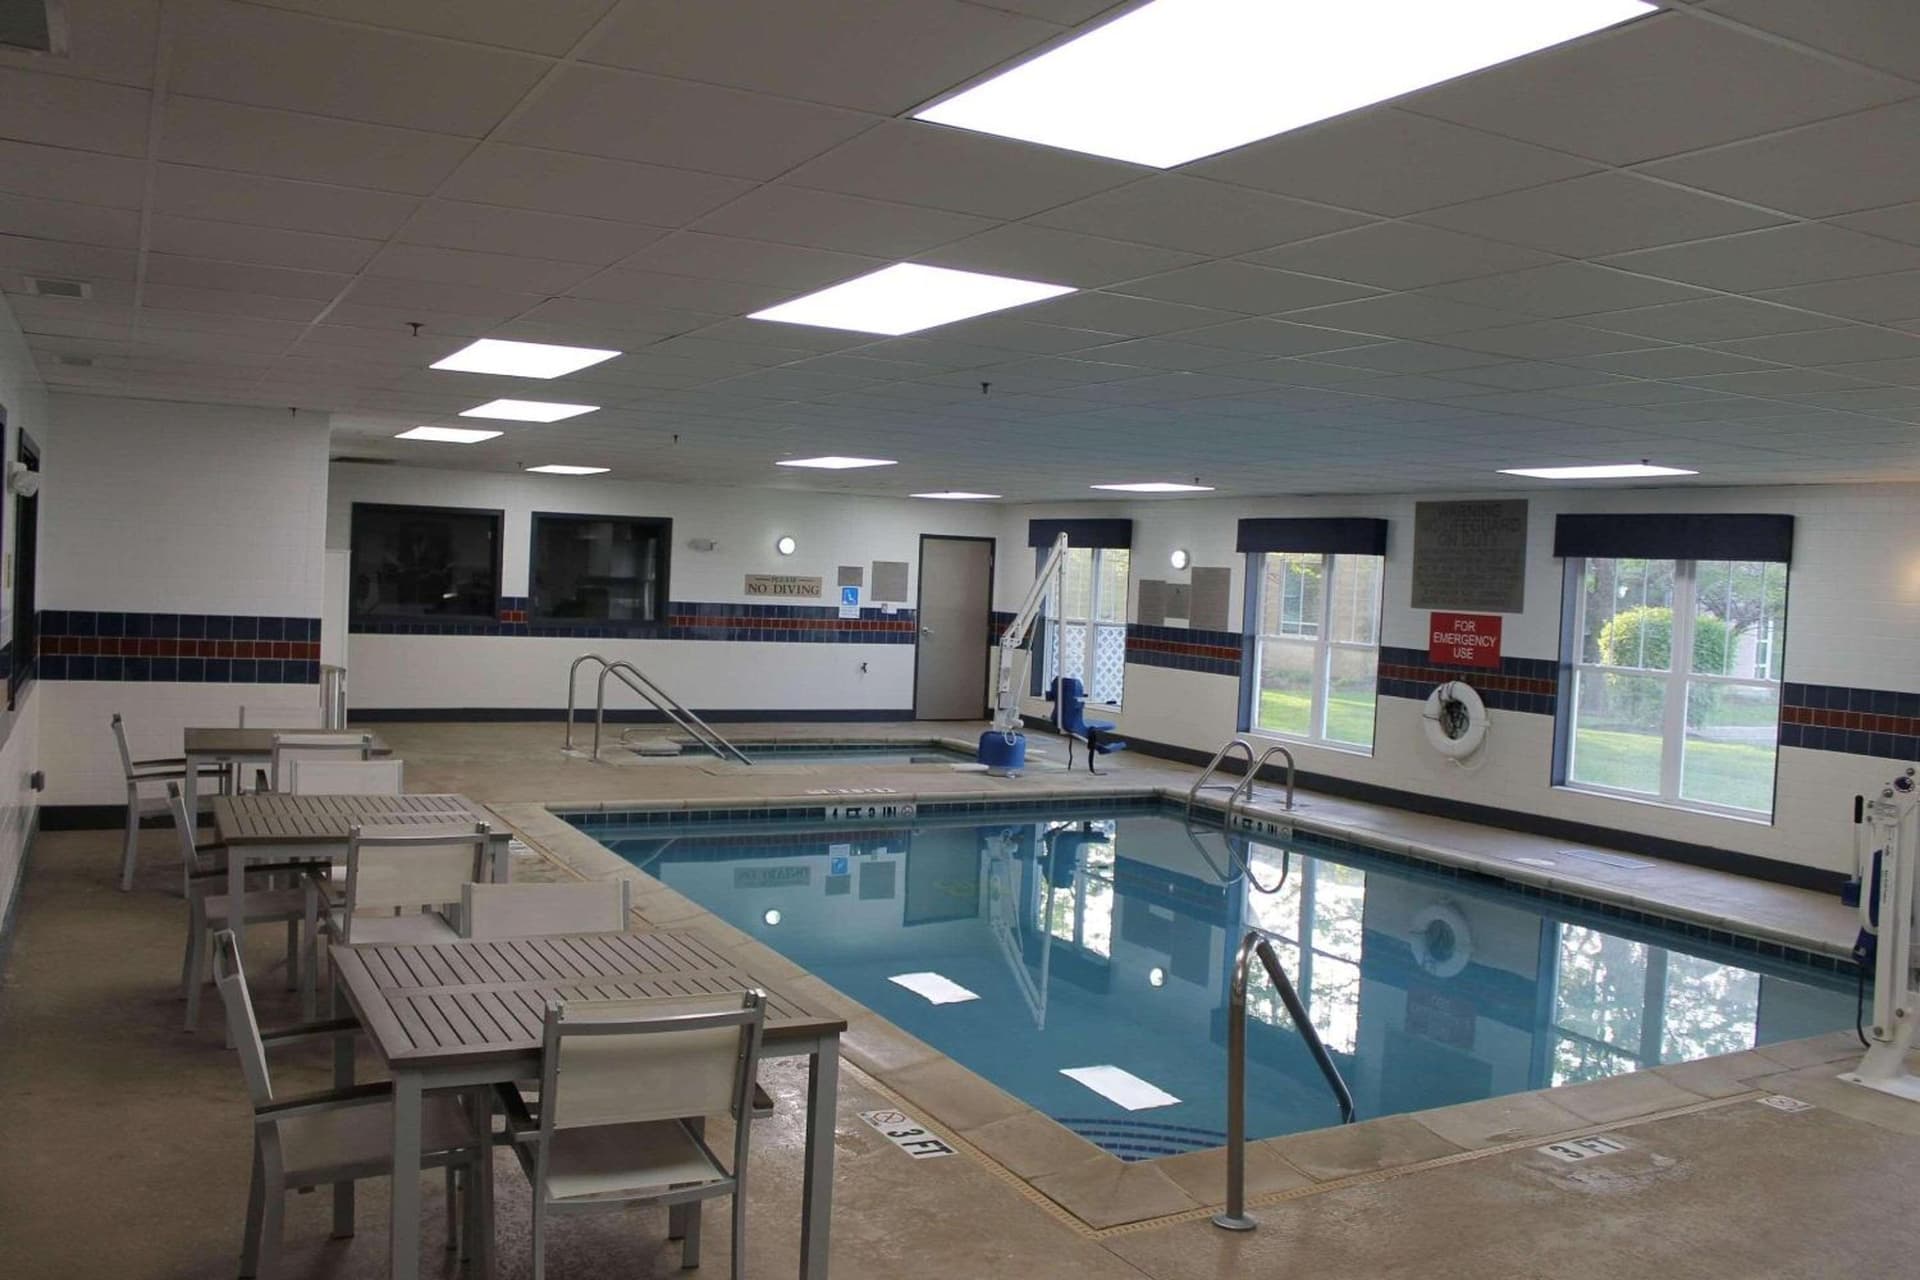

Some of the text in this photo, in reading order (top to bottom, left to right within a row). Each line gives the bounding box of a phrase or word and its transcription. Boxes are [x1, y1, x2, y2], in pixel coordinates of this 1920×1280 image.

[748, 583, 819, 595] NO DIVING
[1454, 620, 1476, 632] FOR
[1433, 631, 1497, 648] EMERGENCY
[1453, 647, 1474, 660] USE
[883, 806, 897, 818] IN
[887, 1128, 953, 1155] 3 FT
[1549, 1137, 1621, 1158] 3 FT
